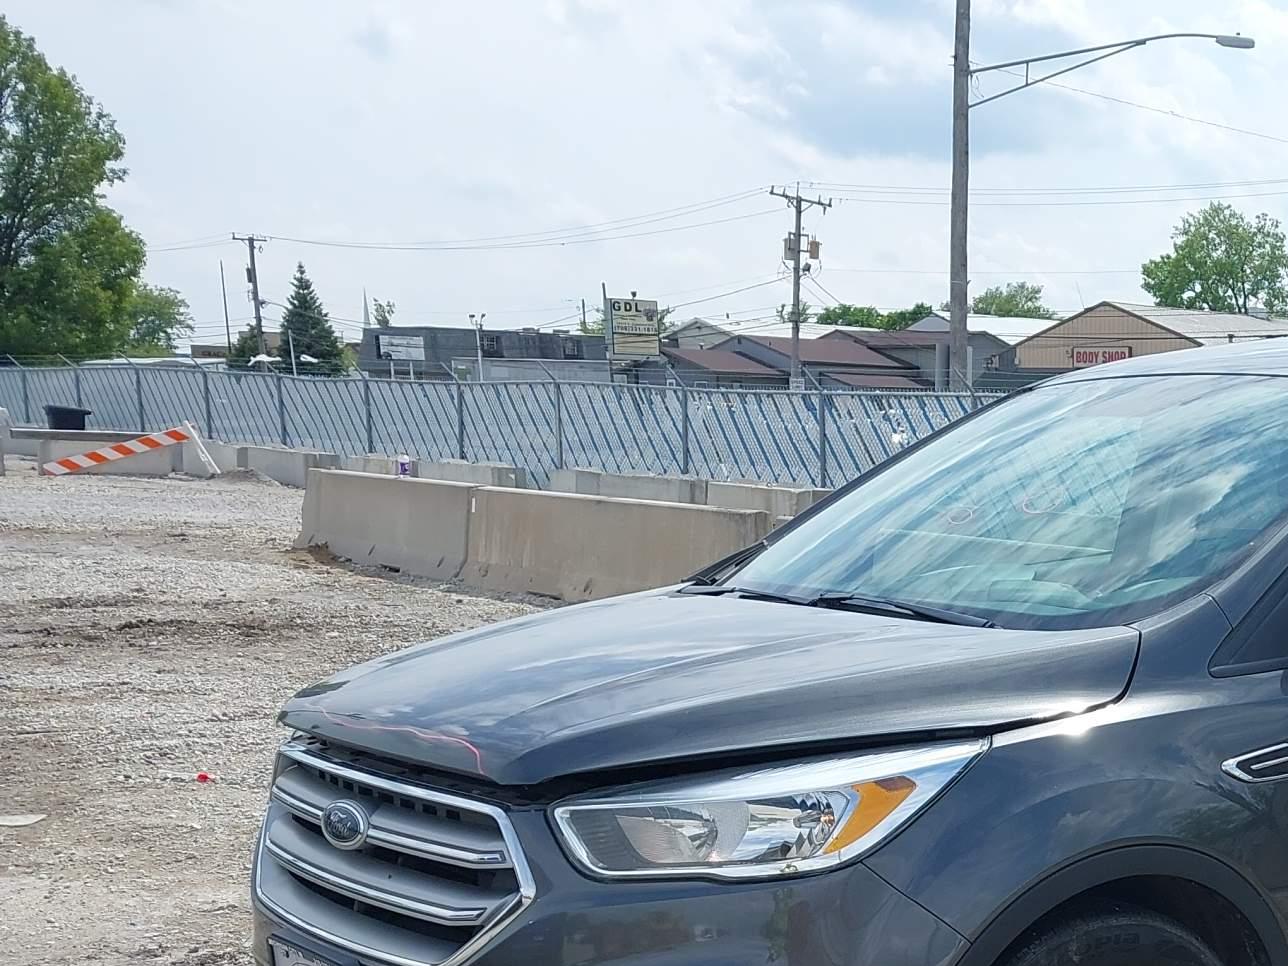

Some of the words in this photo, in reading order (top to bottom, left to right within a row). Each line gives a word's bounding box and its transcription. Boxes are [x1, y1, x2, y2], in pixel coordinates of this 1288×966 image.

[612, 301, 642, 312] GDL
[1075, 350, 1099, 363] BODY
[1102, 350, 1126, 363] SHOP
